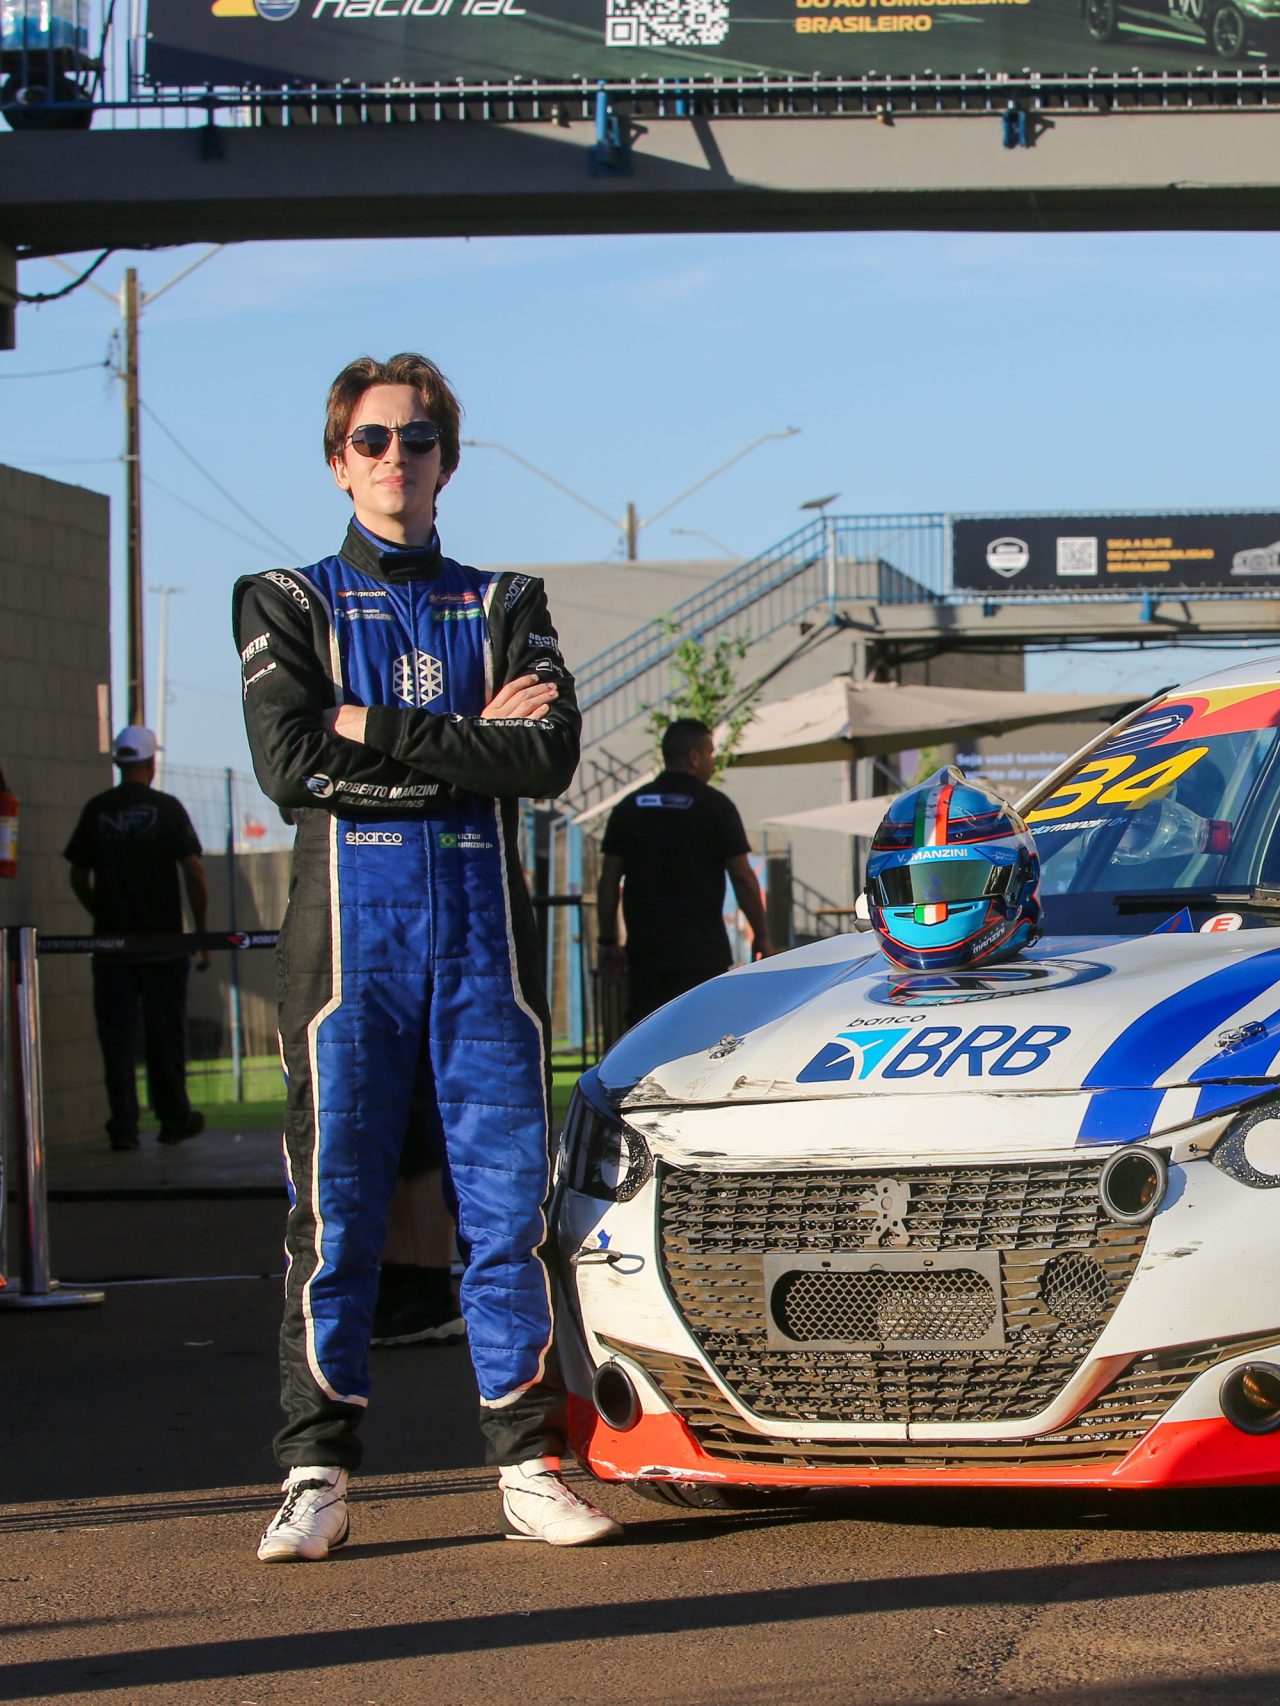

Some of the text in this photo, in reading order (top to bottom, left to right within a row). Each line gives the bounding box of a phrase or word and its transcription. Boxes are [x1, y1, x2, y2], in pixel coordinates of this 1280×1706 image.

[795, 15, 932, 33] BRASILEIRO
[334, 780, 439, 799] ROBERTO MANZINI
[1023, 746, 1210, 824] 34
[345, 831, 403, 846] sparco
[911, 848, 968, 861] MANZINI
[846, 1014, 928, 1028] banco
[881, 1025, 1072, 1078] BRB
